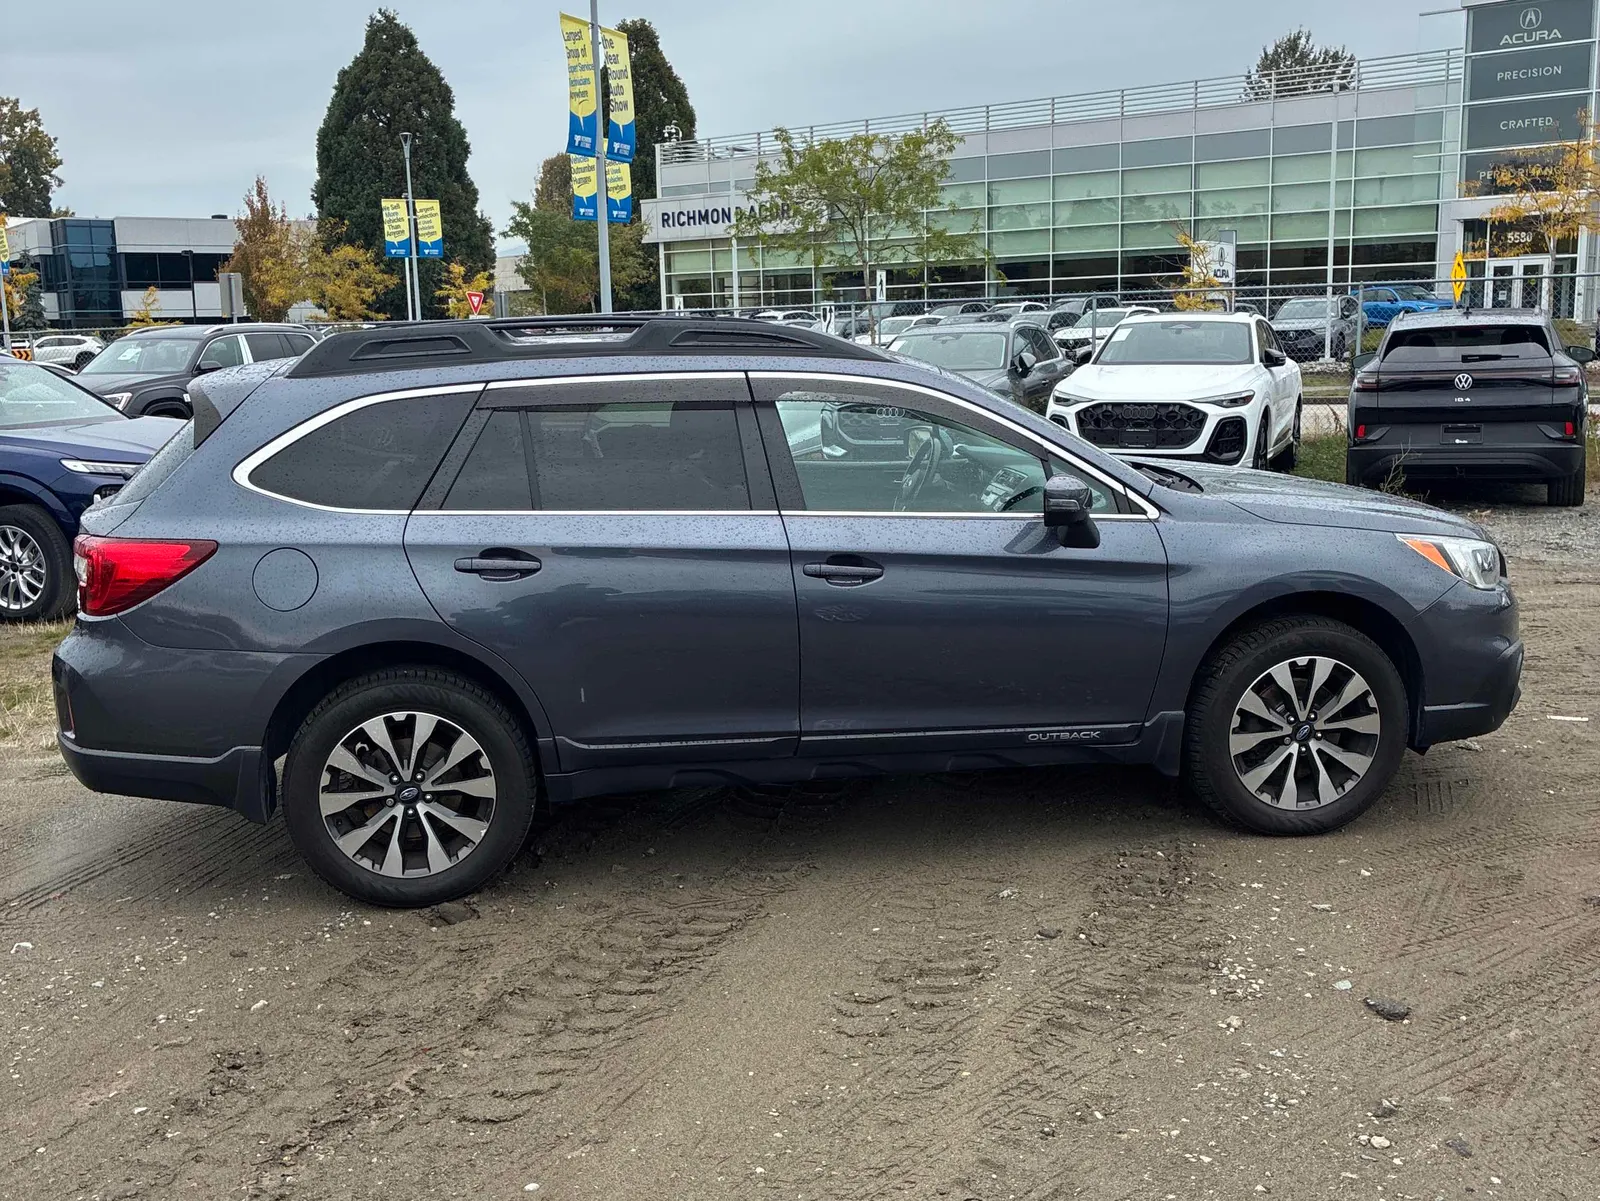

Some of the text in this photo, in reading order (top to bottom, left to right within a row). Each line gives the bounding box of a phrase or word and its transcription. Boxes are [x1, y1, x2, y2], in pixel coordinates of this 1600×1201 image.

[1500, 29, 1562, 45] ACURA
[581, 44, 588, 58] of
[1497, 65, 1562, 81] PRECISION
[610, 98, 629, 113] Show
[1500, 117, 1553, 130] CRAFTED
[1213, 269, 1230, 278] ACURA
[1028, 731, 1101, 741] OUTBACK
